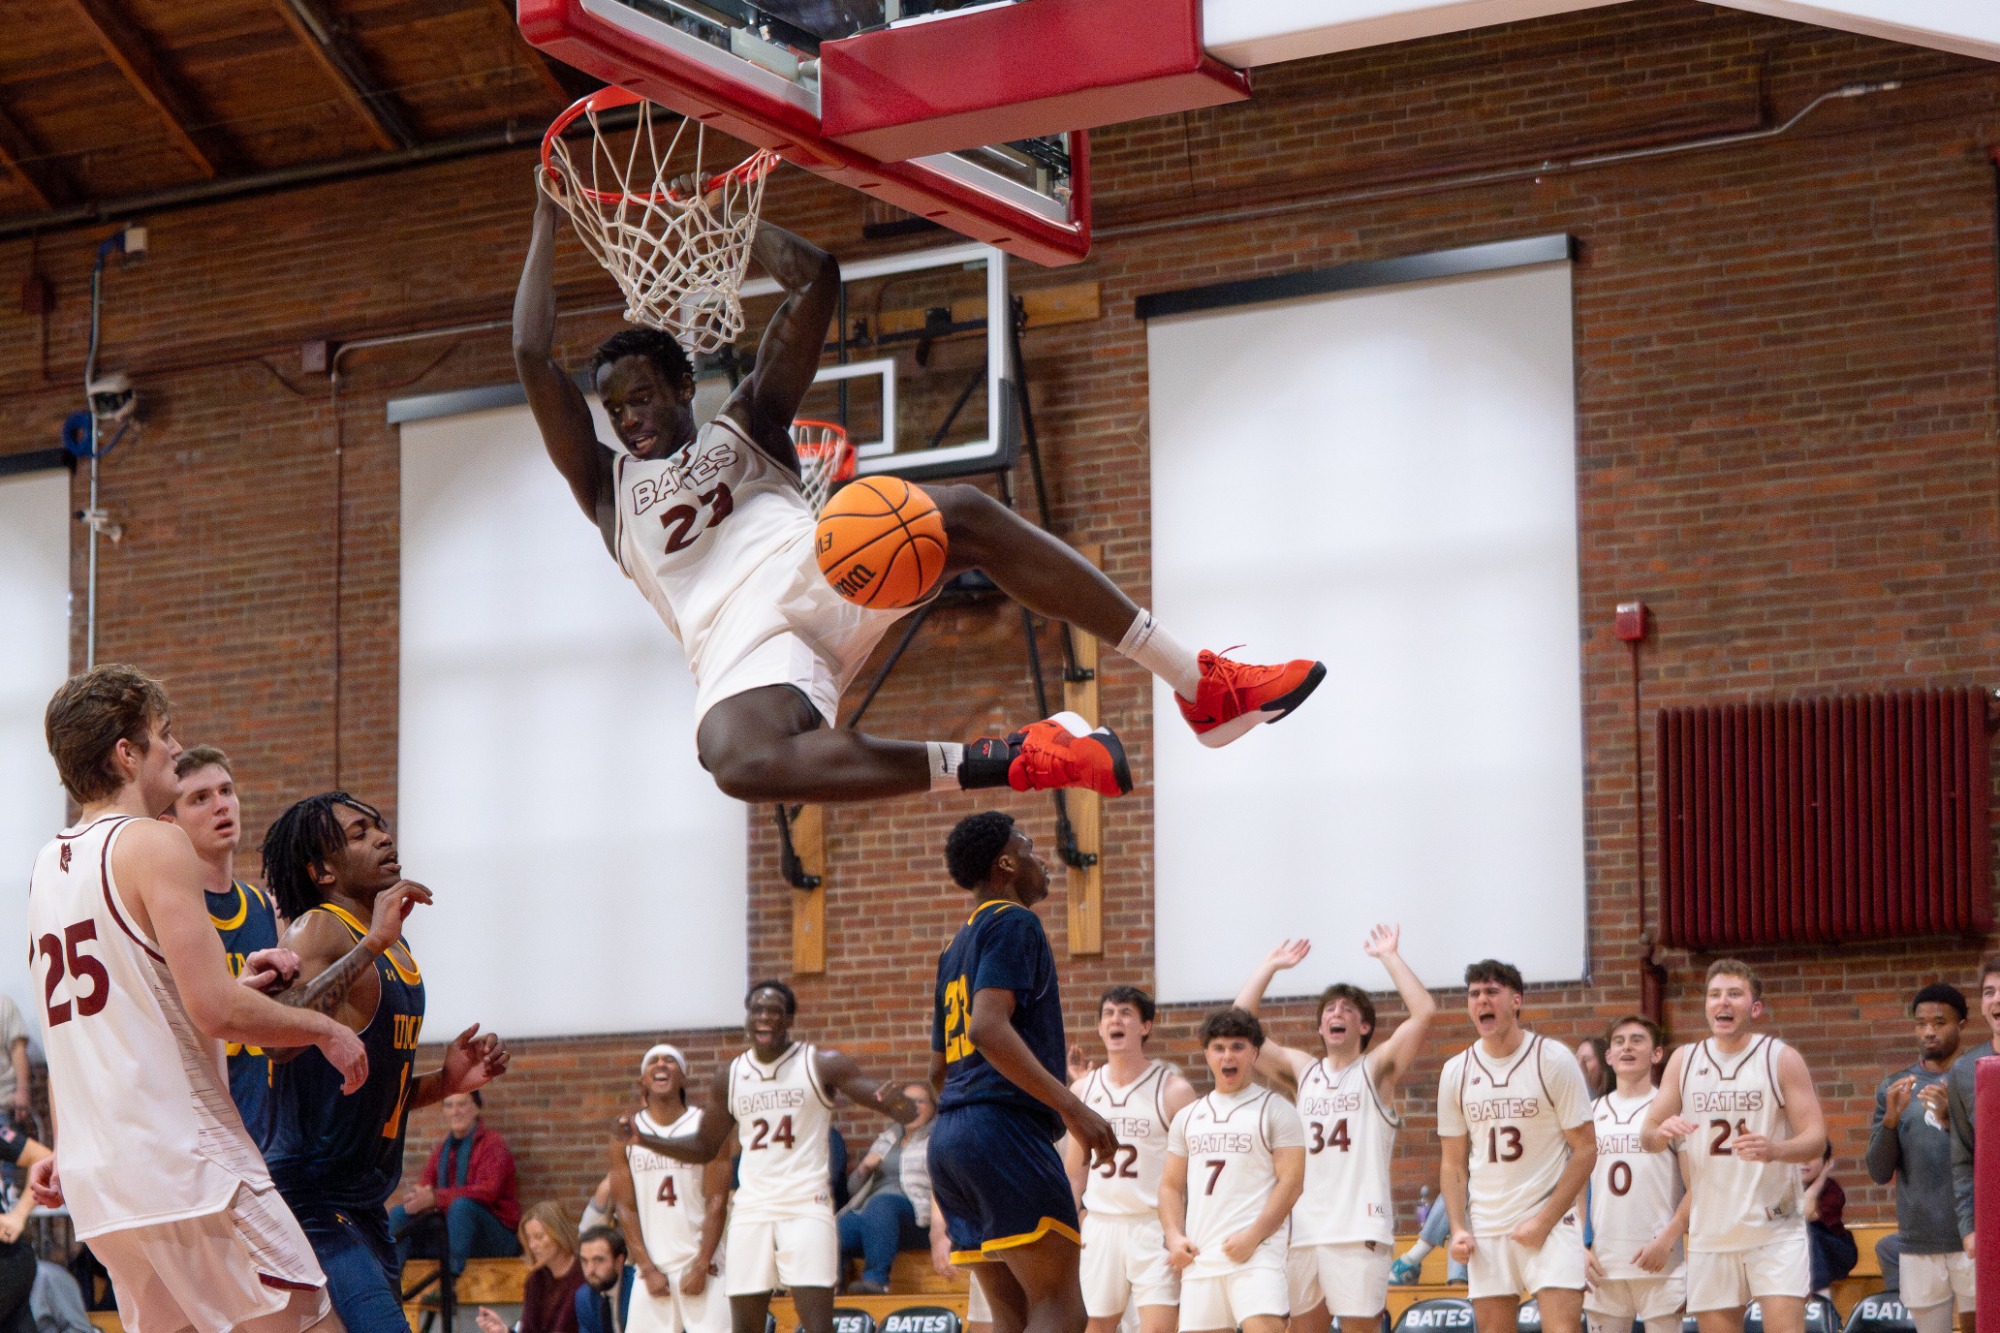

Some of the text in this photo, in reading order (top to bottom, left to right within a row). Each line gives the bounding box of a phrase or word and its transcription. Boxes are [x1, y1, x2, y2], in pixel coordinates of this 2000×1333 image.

[660, 482, 733, 555] 23
[37, 918, 109, 1027] 25
[944, 973, 976, 1064] 23
[738, 1088, 804, 1116] BATES
[1304, 1092, 1361, 1116] BATES
[1466, 1097, 1539, 1122] BATES
[1693, 1091, 1763, 1112] BATES
[750, 1114, 795, 1151] 24
[1107, 1117, 1151, 1138] TES
[1309, 1117, 1351, 1155] 34
[1188, 1132, 1252, 1156] BATES
[1487, 1125, 1524, 1164] 13
[1596, 1133, 1647, 1155] ATE
[656, 1175, 678, 1207] 4
[1204, 1159, 1226, 1196] 7
[1608, 1160, 1632, 1197] 0
[885, 1316, 948, 1332] BATES
[1405, 1308, 1472, 1327] BATES
[1862, 1301, 1914, 1321] BAT
